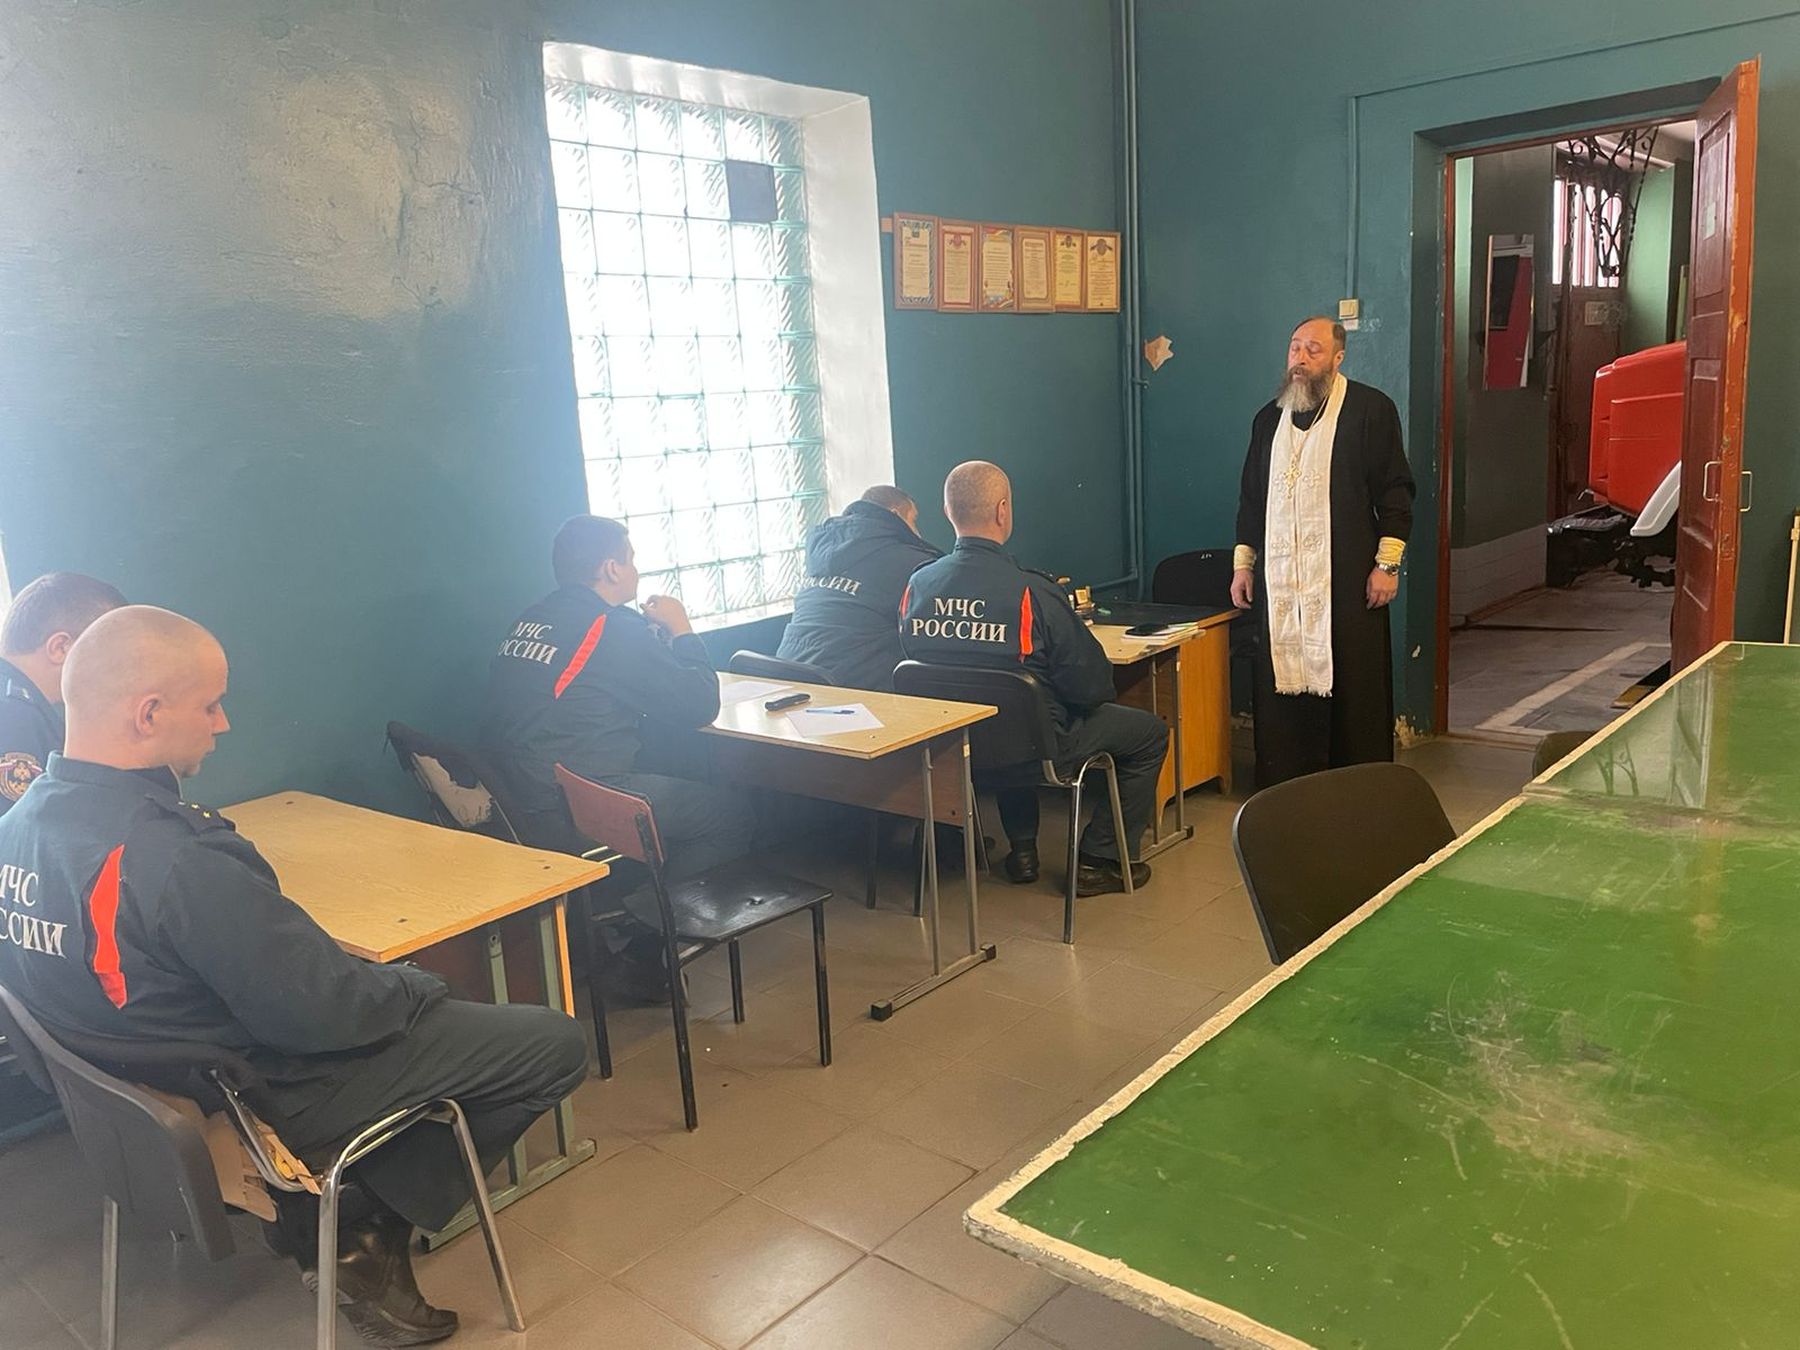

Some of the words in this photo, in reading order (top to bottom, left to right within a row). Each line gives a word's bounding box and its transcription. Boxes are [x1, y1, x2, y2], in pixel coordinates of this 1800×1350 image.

[934, 598, 985, 618] МЧС
[912, 618, 1007, 643] РОССИИ
[498, 639, 558, 665] ОССИИ
[0, 906, 68, 959] ССИИ
